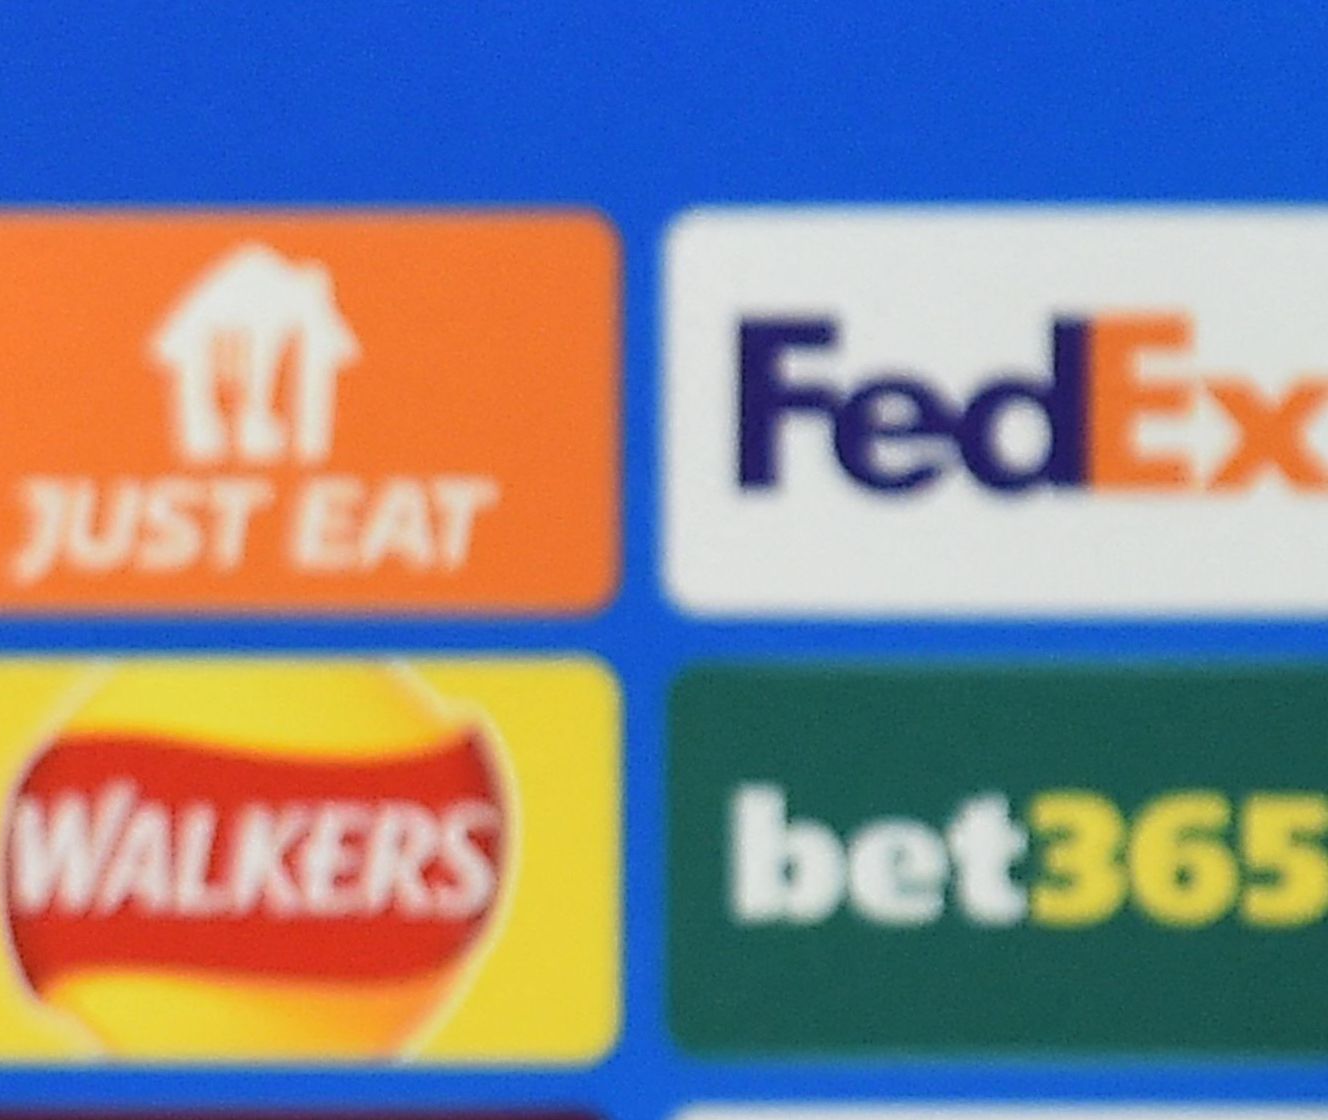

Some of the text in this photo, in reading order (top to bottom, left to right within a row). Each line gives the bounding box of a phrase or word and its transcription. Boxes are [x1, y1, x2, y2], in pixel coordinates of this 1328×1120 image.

[737, 312, 1328, 496] FedEx
[12, 474, 501, 586] JUST EAT
[8, 779, 501, 918] WALKERS
[730, 782, 1328, 928] bet365
